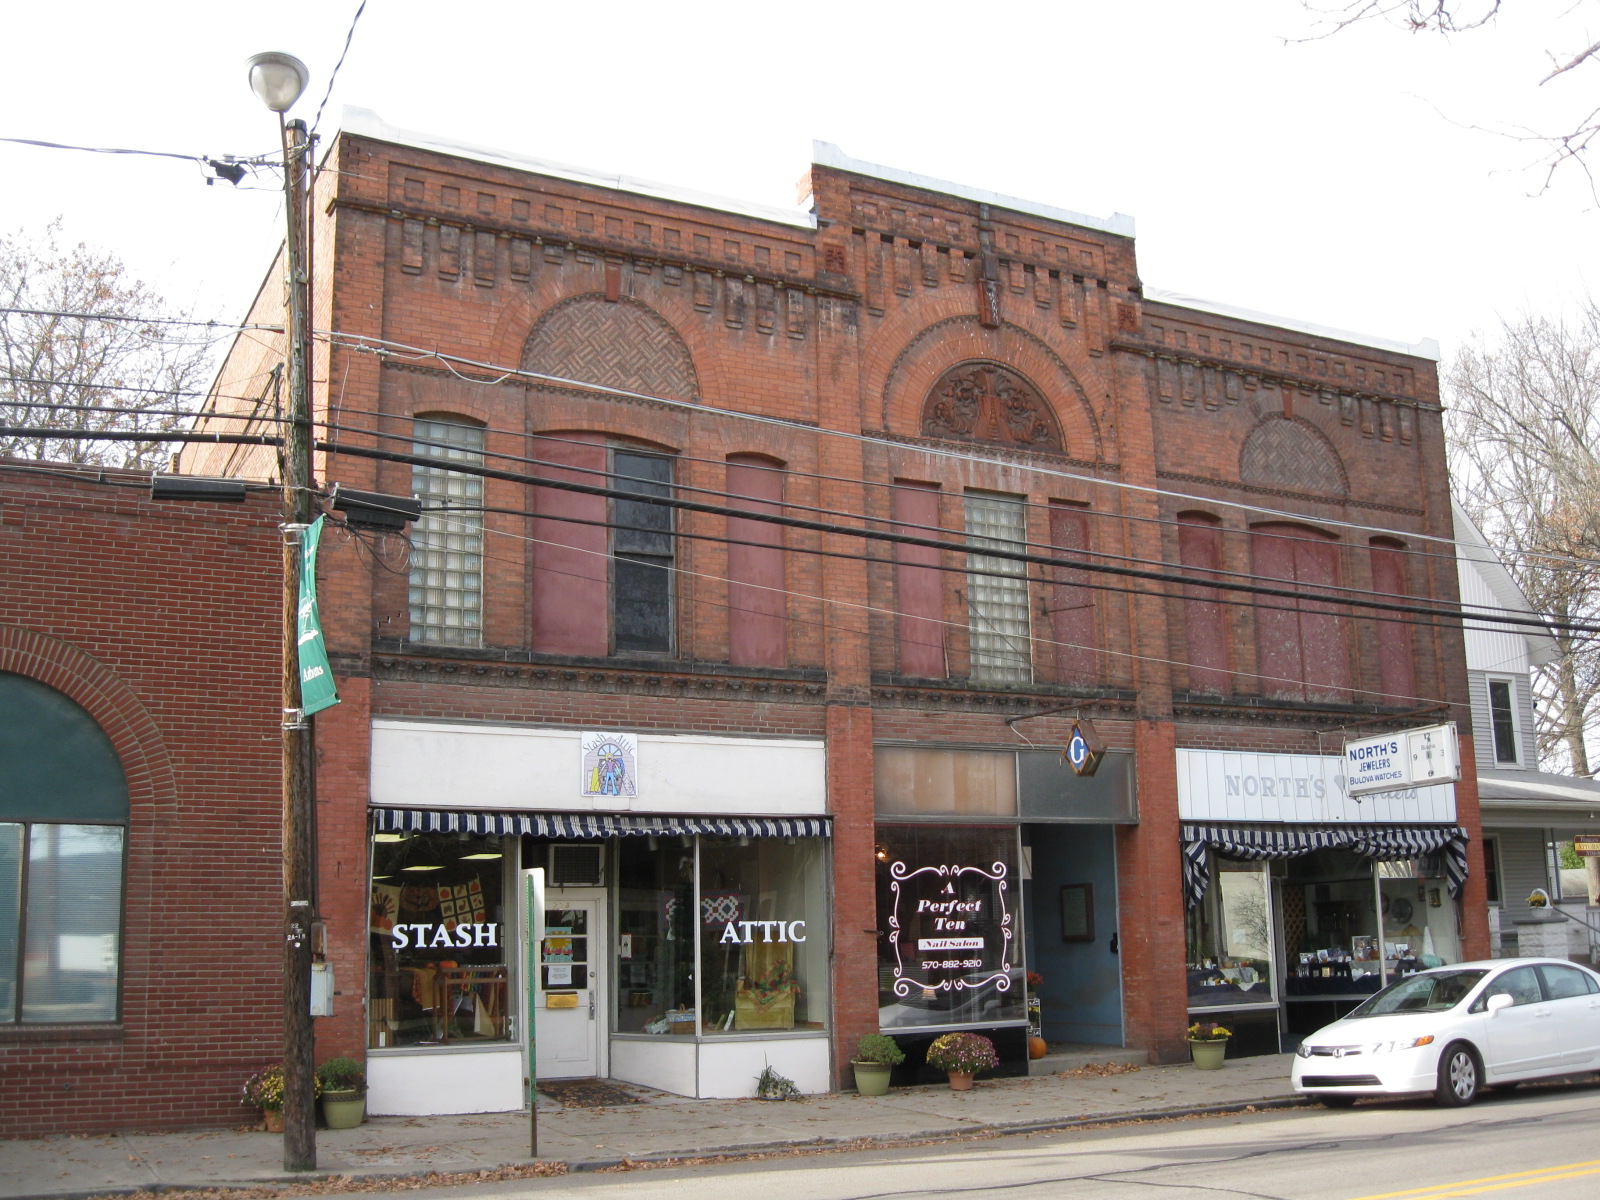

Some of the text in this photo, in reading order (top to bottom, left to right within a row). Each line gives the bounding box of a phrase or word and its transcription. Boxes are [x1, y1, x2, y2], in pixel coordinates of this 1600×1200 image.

[582, 733, 636, 753] Stash Attic
[1070, 736, 1085, 764] G
[1349, 742, 1398, 761] NORTH'S
[1359, 759, 1390, 772] JEWELERS
[1374, 771, 1402, 780] WATCHES
[1225, 774, 1326, 799] NORTH'S
[940, 881, 956, 894] A
[916, 900, 981, 915] Perfect
[719, 920, 807, 944] ATTIC
[934, 918, 966, 930] Ten
[392, 923, 498, 949] STASH
[921, 959, 982, 970] 570-882-9210
